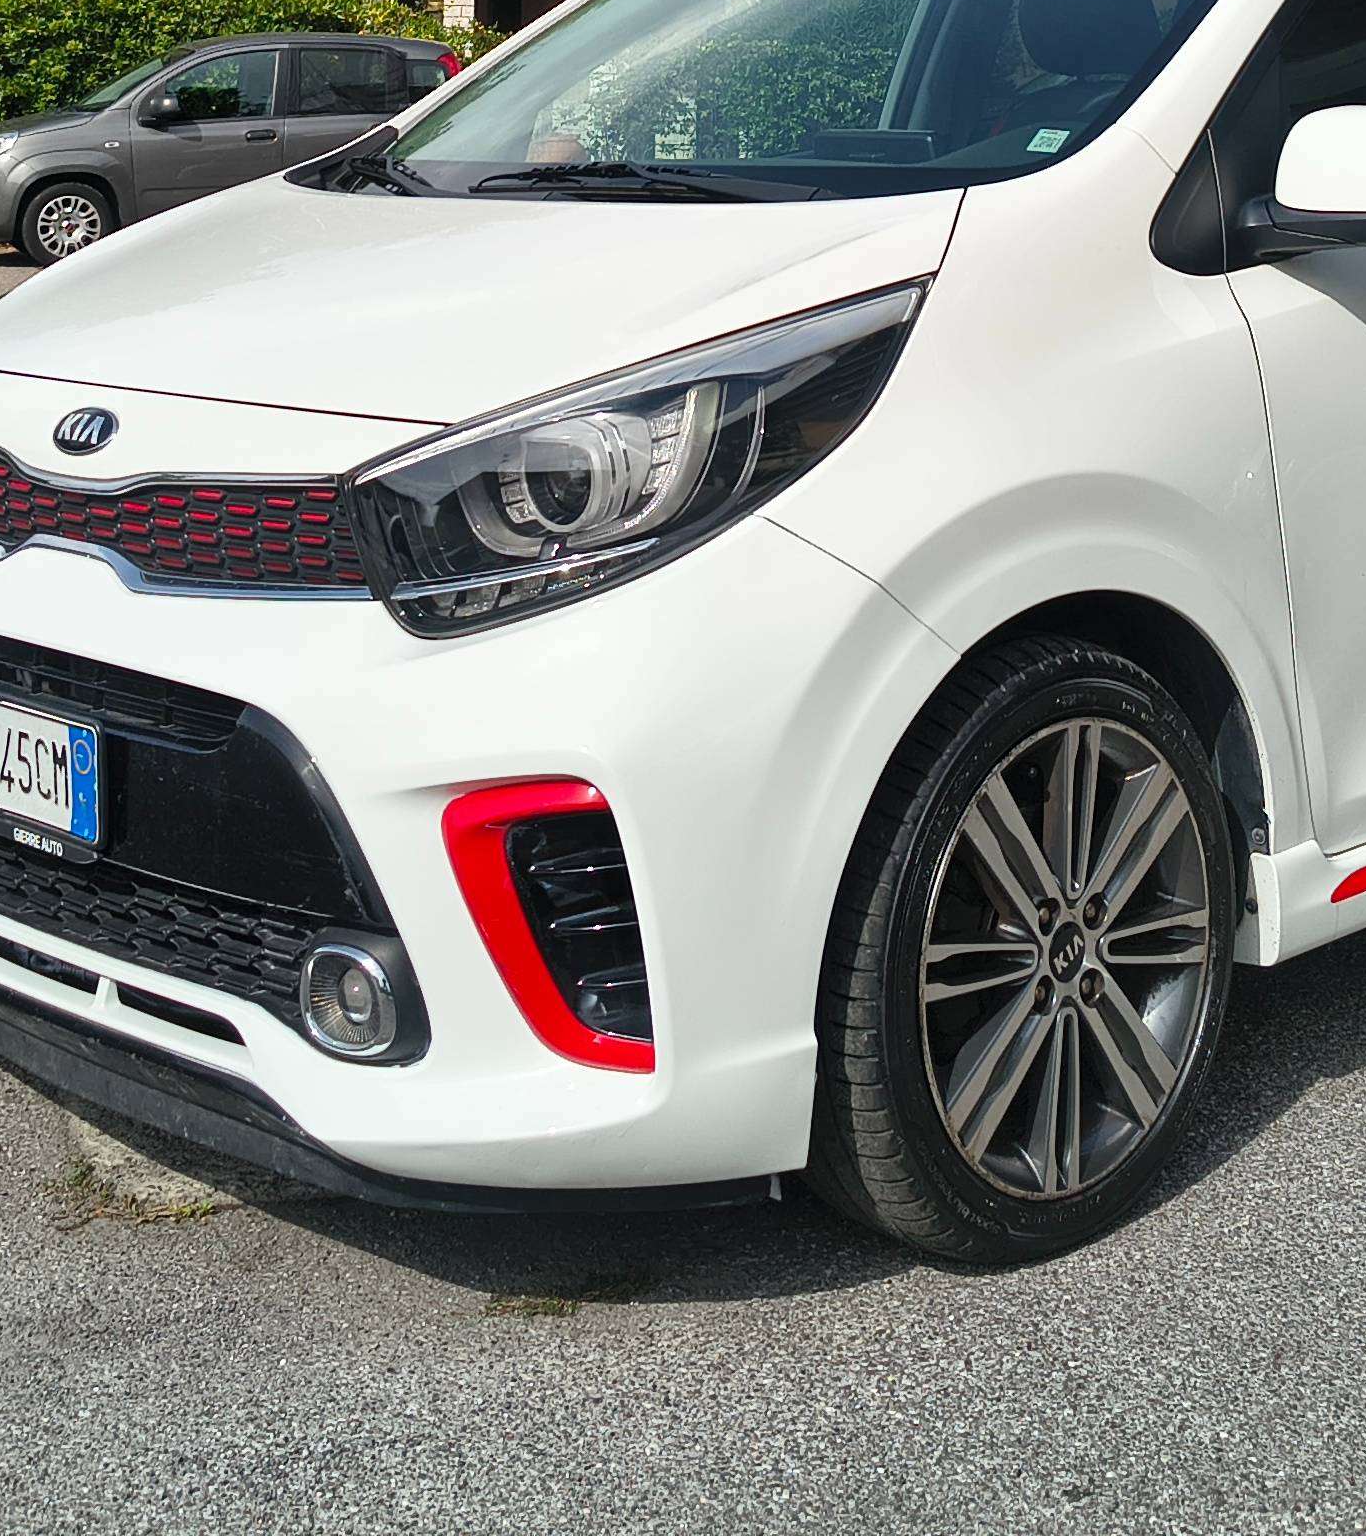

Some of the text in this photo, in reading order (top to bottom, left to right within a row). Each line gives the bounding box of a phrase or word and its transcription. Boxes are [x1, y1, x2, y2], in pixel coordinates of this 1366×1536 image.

[57, 413, 105, 445] KIA
[41, 837, 64, 857] AUTO
[1053, 934, 1085, 975] KIA
